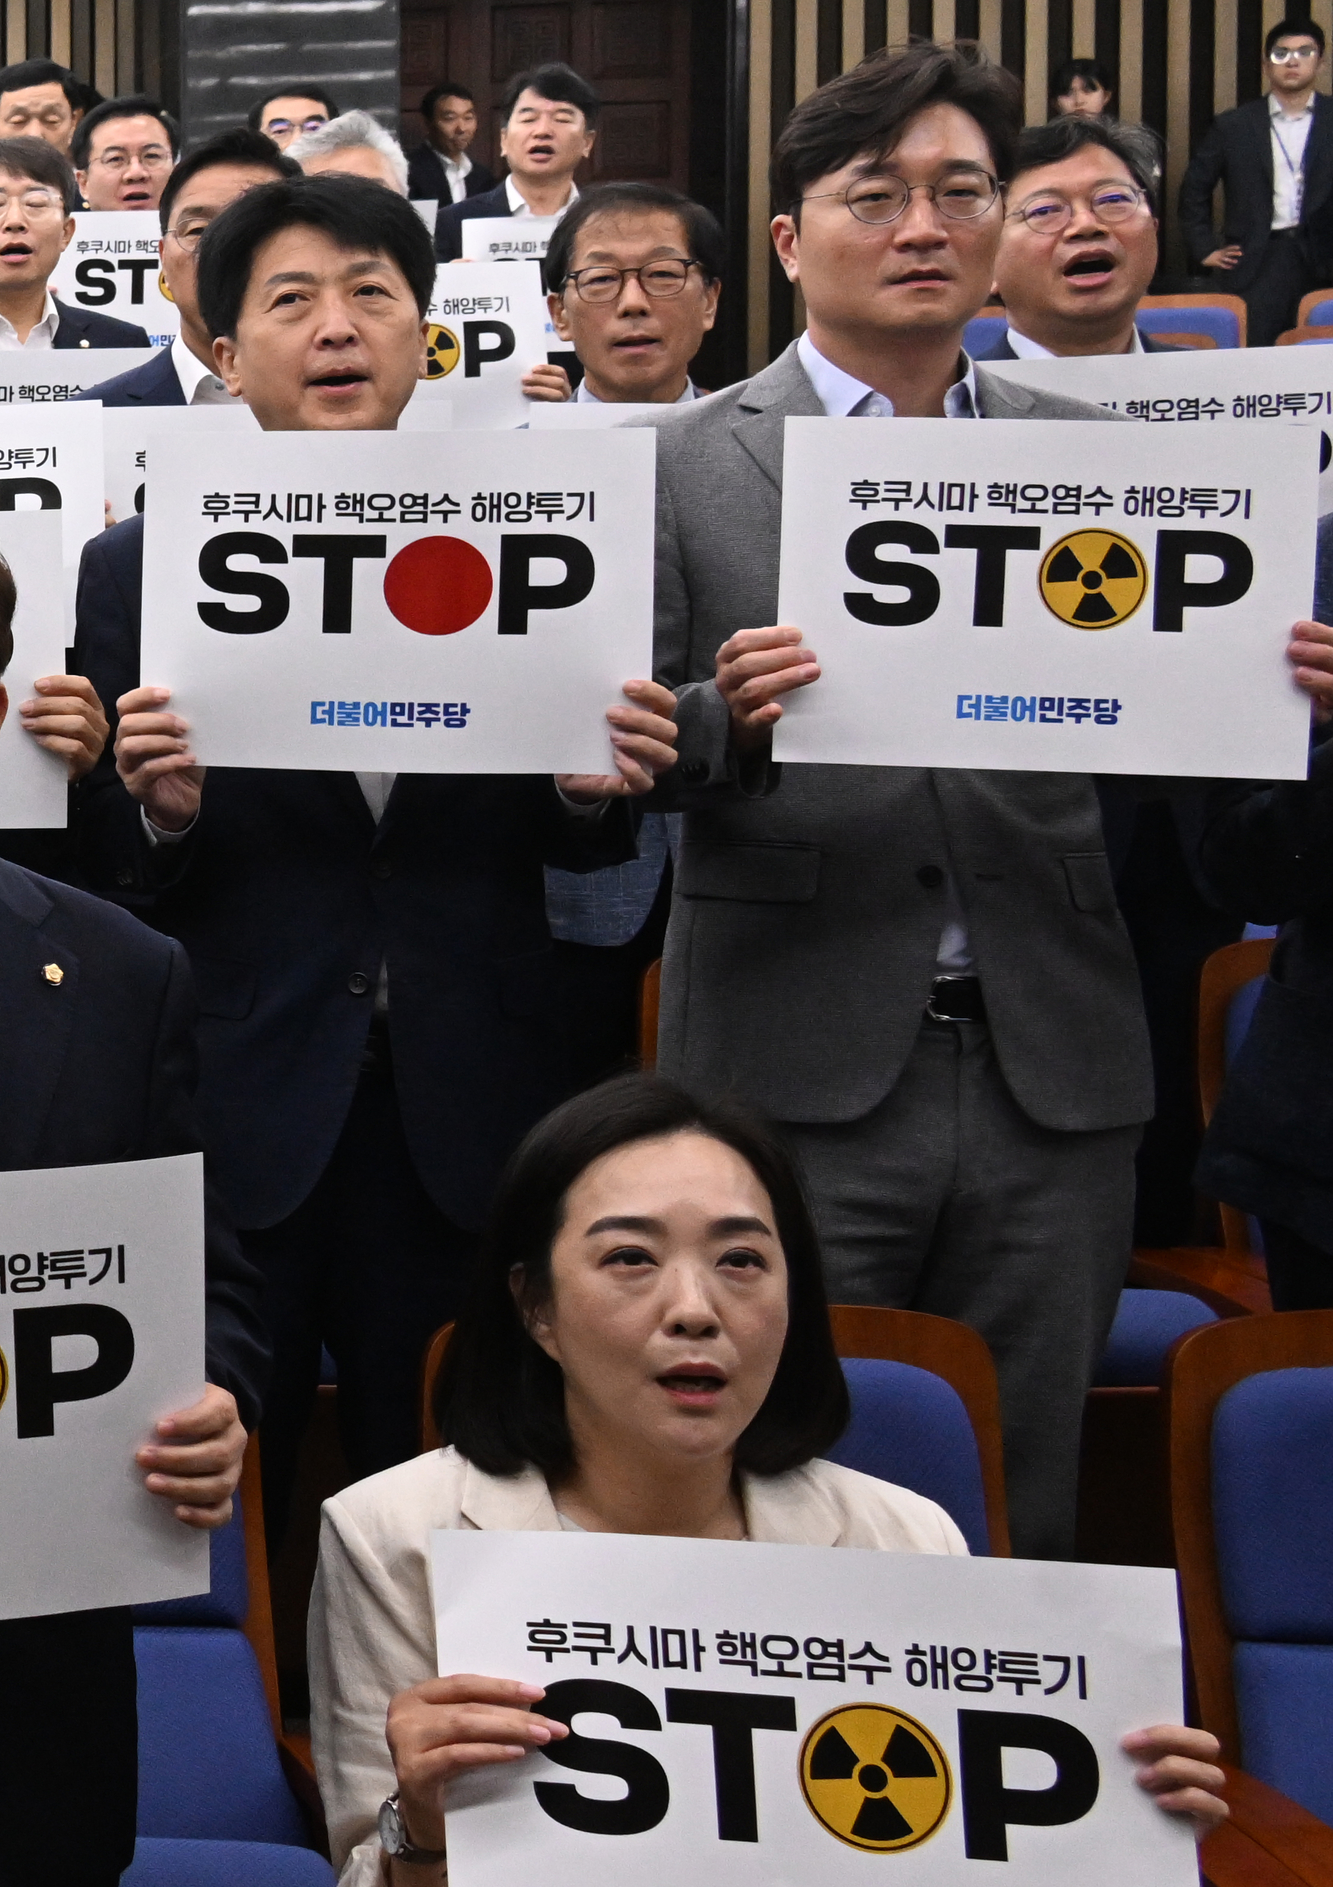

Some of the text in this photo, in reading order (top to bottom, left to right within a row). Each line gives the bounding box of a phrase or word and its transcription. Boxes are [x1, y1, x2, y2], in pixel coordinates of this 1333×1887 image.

[443, 296, 510, 315] 해양투기
[1233, 391, 1332, 419] 해양투기
[201, 491, 595, 524] 후쿠시마 핵오염수 해양투기
[849, 479, 1252, 520] 후쿠시마 핵오염수 해양투기
[310, 700, 470, 728] 더불어민주당
[956, 693, 1122, 725] 더불어민주당
[526, 1617, 1088, 1700] 후쿠시마 핵오염수 해양투기
